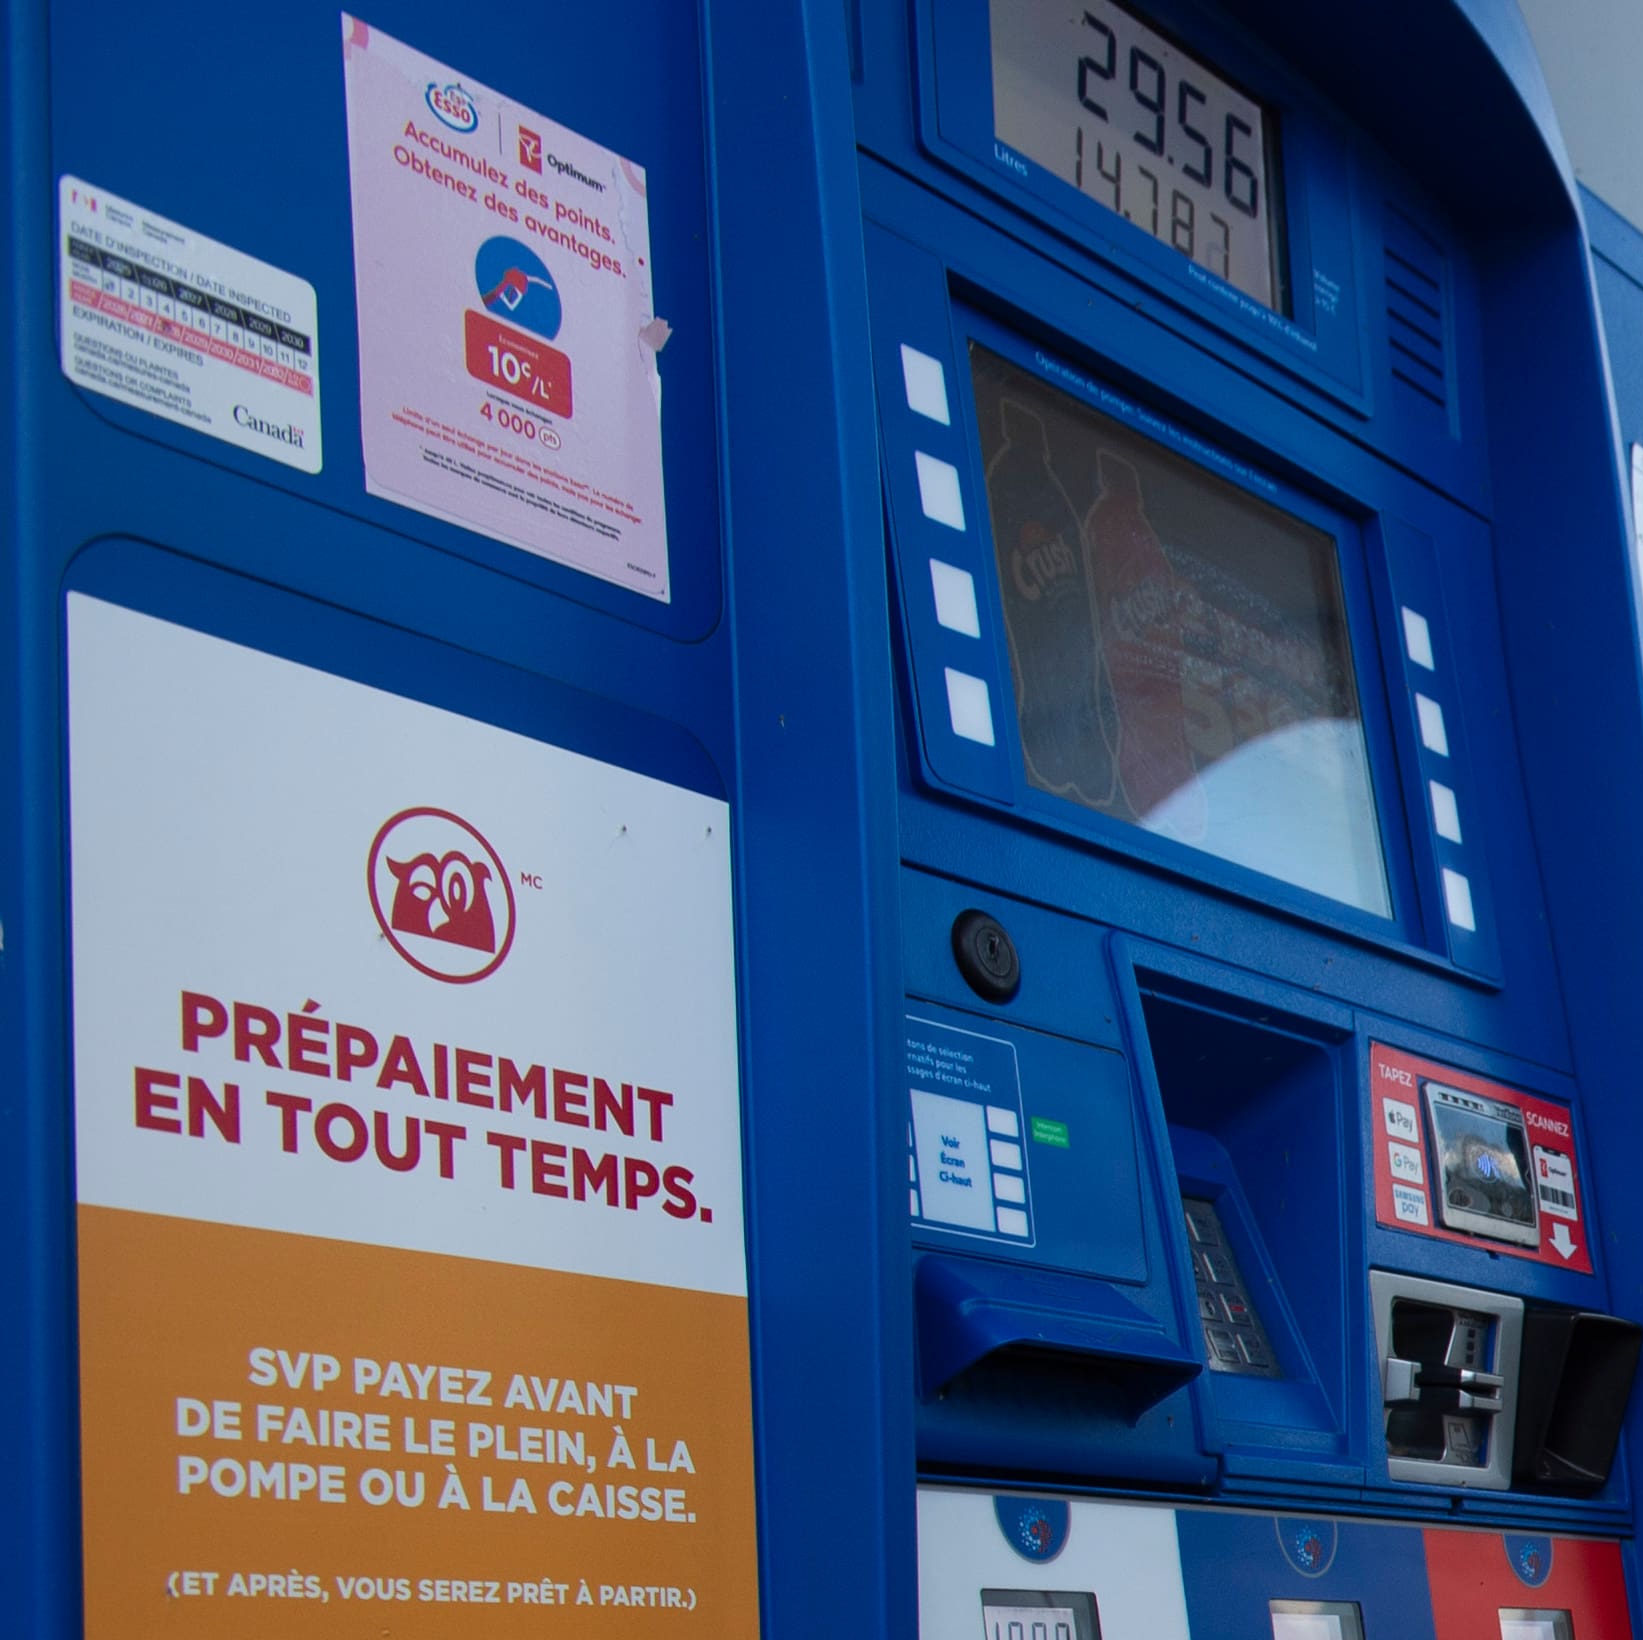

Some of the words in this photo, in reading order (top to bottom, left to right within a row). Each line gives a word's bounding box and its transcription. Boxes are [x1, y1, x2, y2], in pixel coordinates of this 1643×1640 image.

[1077, 10, 1259, 219] 29.56
[546, 153, 606, 193] Optimum
[993, 143, 1029, 176] Litres
[404, 121, 509, 188] Accumulez
[515, 180, 549, 209] des
[555, 200, 616, 245] points.
[393, 145, 478, 202] Obtenez
[484, 193, 519, 223] des
[525, 214, 627, 278] avantages.
[71, 221, 101, 242] DATE
[196, 274, 227, 296] DATE
[229, 285, 292, 324] INSPECTED
[73, 306, 145, 346] EXPIRATION
[153, 337, 204, 368] EXPIRES
[232, 403, 306, 450] Canada
[480, 400, 494, 423] 4
[497, 408, 537, 441] 000
[1010, 530, 1079, 602] Crush
[519, 871, 544, 892] MC
[180, 989, 674, 1143] PRÉPAIEMENT
[1378, 1063, 1413, 1087] TAPEZ
[940, 1135, 961, 1150] Voir
[1396, 1111, 1414, 1134] Pay
[1525, 1111, 1570, 1137] SCANNEZ
[133, 1066, 241, 1145] EN
[265, 1089, 467, 1181] TOUT
[486, 1130, 714, 1225] TEMPS.
[939, 1151, 966, 1170] Écran
[1402, 1155, 1419, 1174] Pay
[938, 1170, 974, 1189] Ci-haut
[1401, 1201, 1420, 1218] pay
[248, 1346, 341, 1393] SVP
[353, 1357, 493, 1407] PAYEZ
[504, 1374, 639, 1420] AVANT
[175, 1397, 243, 1440] DE
[256, 1403, 392, 1452] FAIRE
[404, 1417, 456, 1456] LE
[469, 1423, 598, 1474] PLEIN,
[606, 1425, 638, 1471] À
[646, 1439, 697, 1475] LA
[176, 1455, 348, 1504] POMPE
[359, 1468, 425, 1509] OU
[437, 1463, 470, 1511] À
[482, 1478, 538, 1515] LA
[548, 1481, 698, 1524] CAISSE.
[167, 1570, 219, 1598] (ET
[227, 1568, 330, 1604] APRÈS,
[336, 1576, 412, 1602] VOUS
[418, 1578, 501, 1605] SEREZ
[507, 1576, 569, 1606] PRÊT
[575, 1577, 594, 1606] À
[598, 1585, 698, 1612] PARTIR.)
